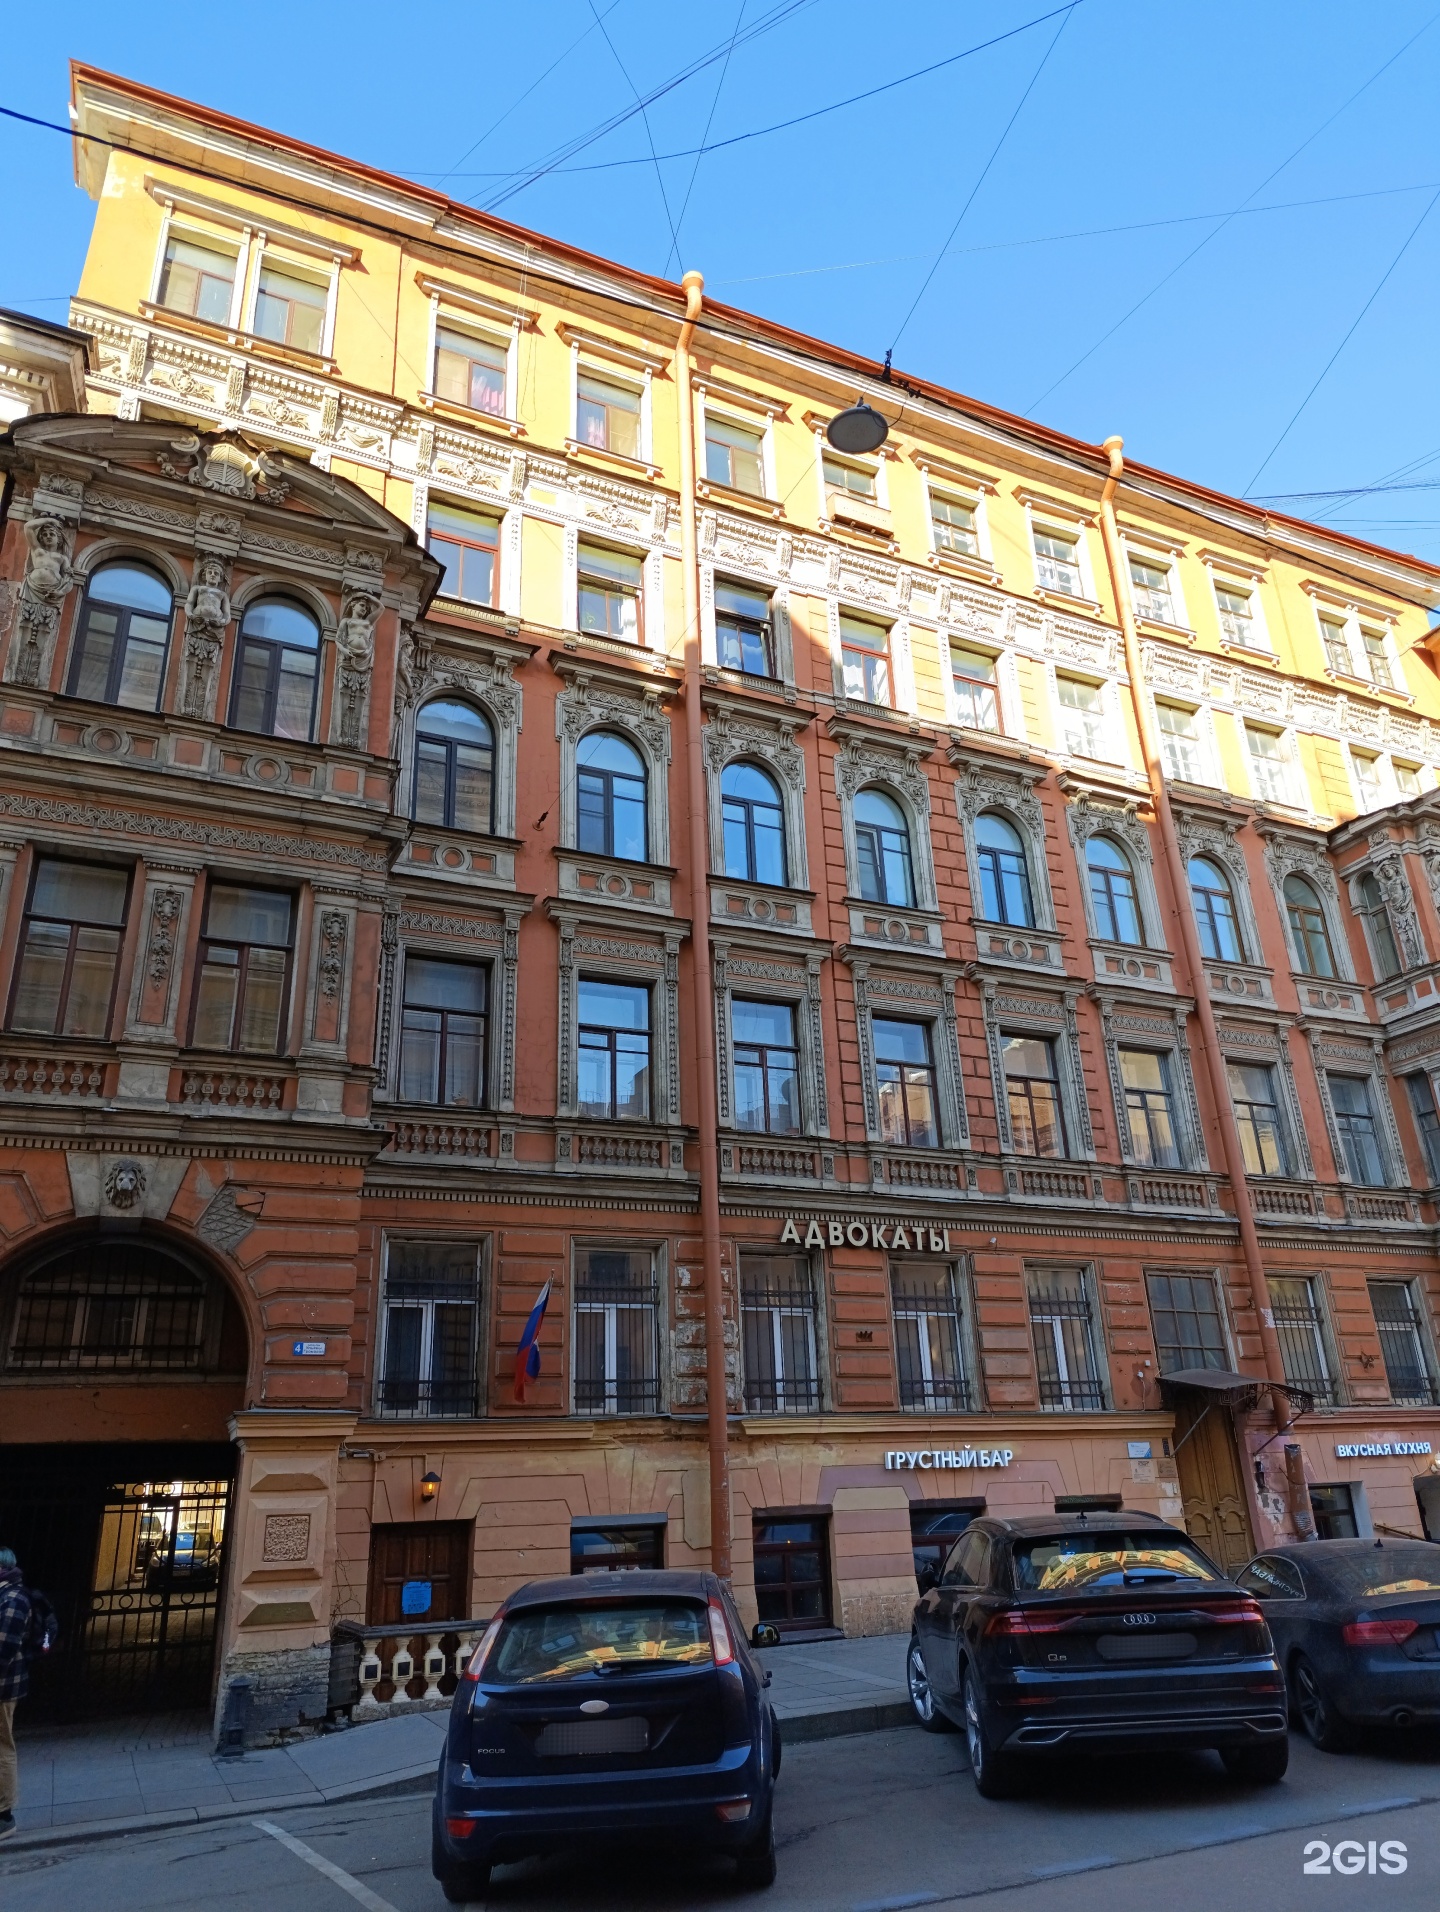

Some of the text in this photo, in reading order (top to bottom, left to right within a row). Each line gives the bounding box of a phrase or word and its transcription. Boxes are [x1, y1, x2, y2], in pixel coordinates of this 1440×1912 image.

[780, 1218, 951, 1253] АДВОКАТЫ
[294, 1343, 302, 1353] 4
[885, 1444, 1013, 1470] ГРУСТНЫЙ БАР
[1336, 1441, 1432, 1458] ВКУСНАЯ КУХНЯ
